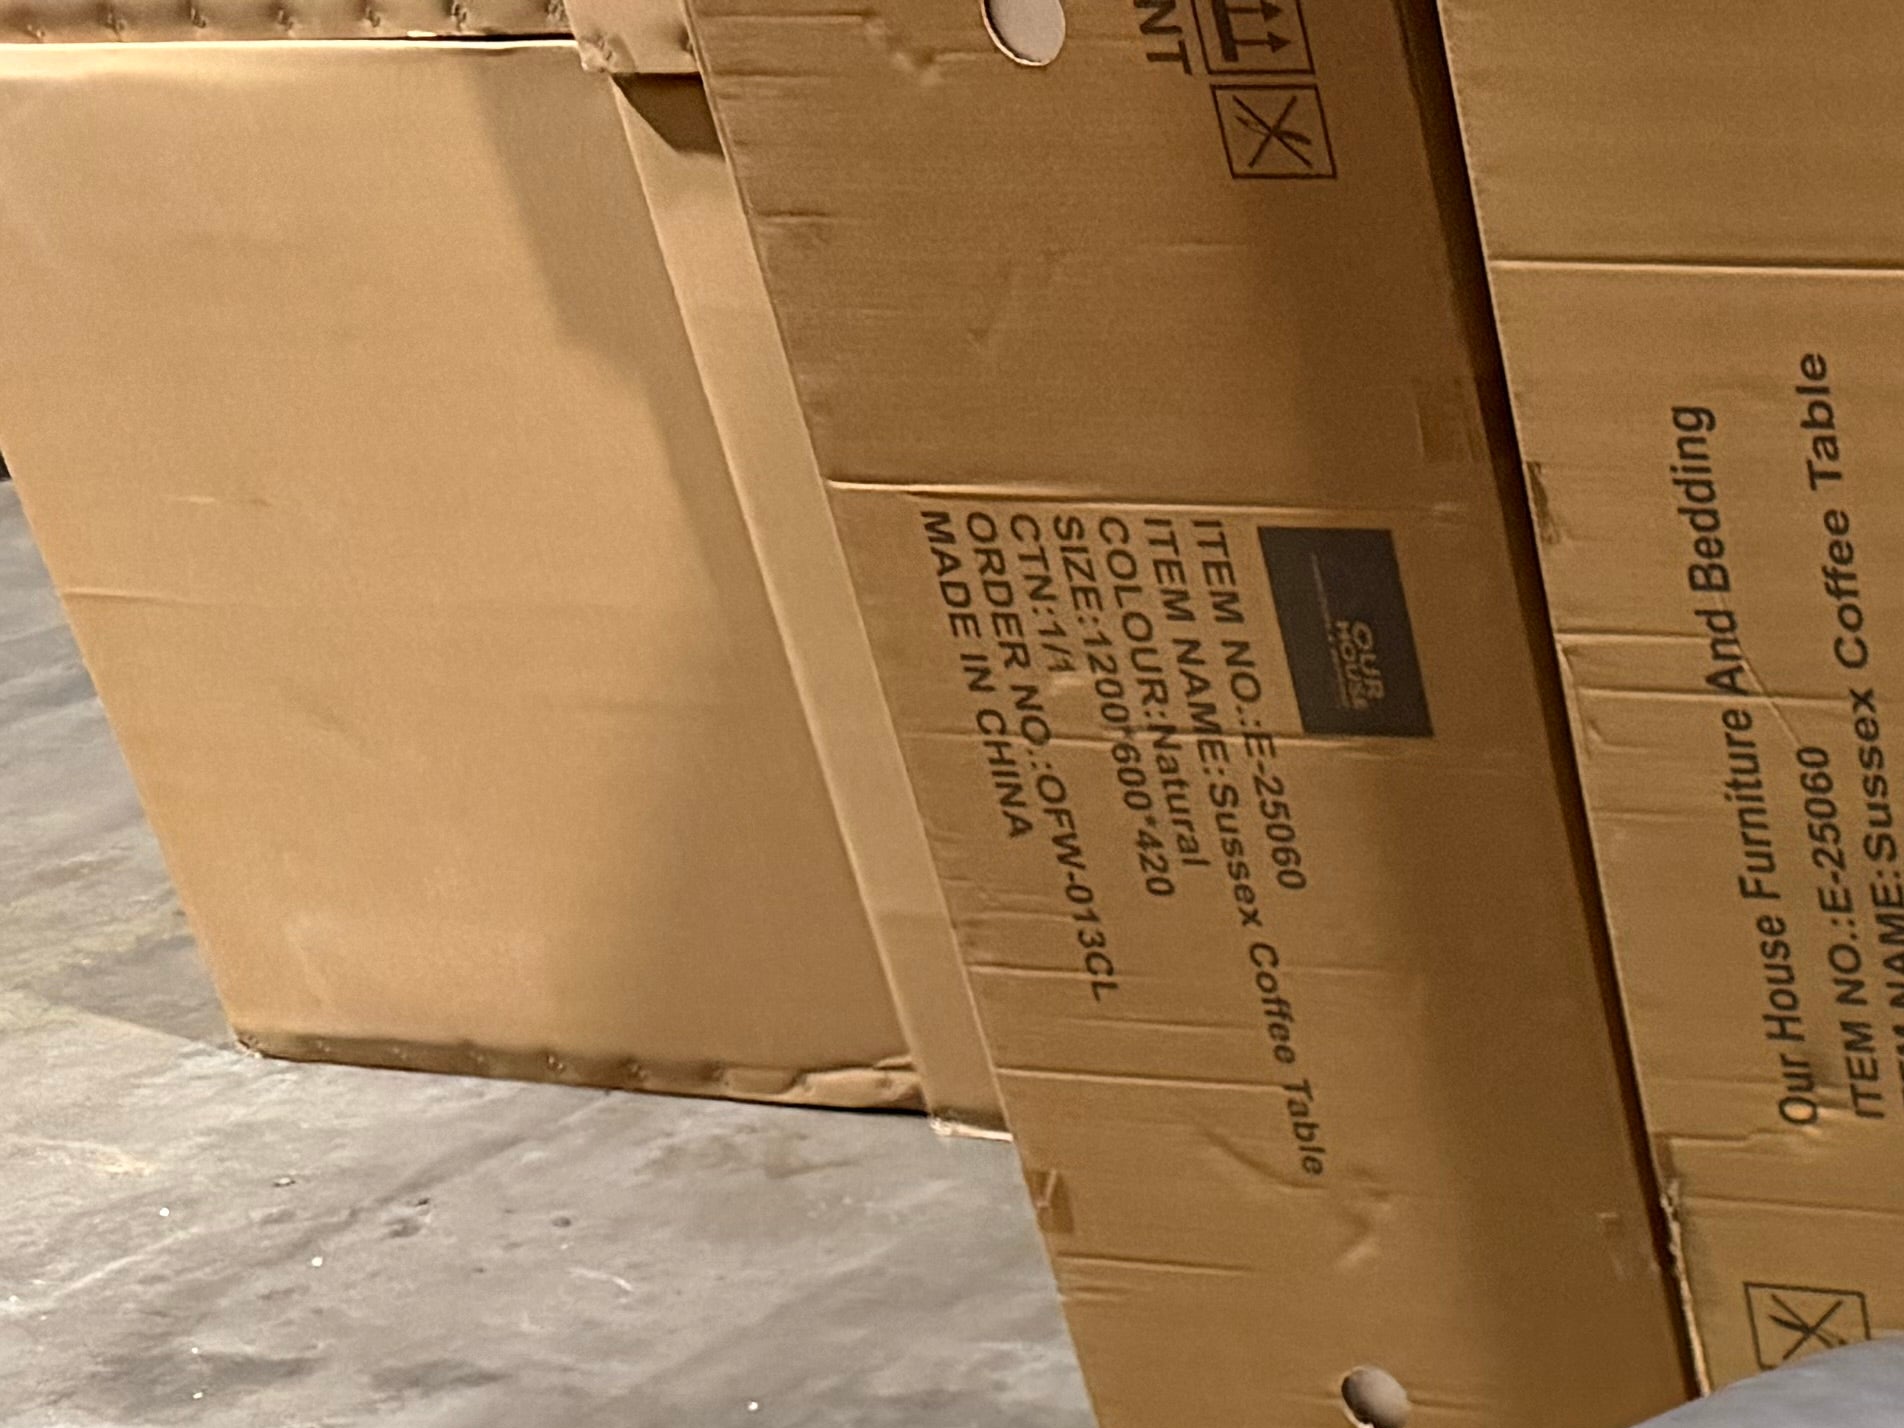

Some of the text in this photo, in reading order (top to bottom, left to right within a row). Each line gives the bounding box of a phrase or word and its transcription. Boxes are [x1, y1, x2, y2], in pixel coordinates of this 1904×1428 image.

[1010, 513, 1076, 673] CTN:1/1
[1795, 352, 1843, 491] Table
[1821, 508, 1869, 669] Coffee
[921, 510, 1034, 839] MADE IN CHINA
[966, 511, 1118, 1003] ORDER NO.:OFW-013CL
[1099, 516, 1211, 867] COLOUR:Natural
[1192, 520, 1307, 890] ITEM NO.:E-25060
[1351, 620, 1385, 700] OUR
[1670, 405, 1818, 1125] Our House Furniture And Bedding
[1144, 518, 1328, 1177] ITEM NAME:Sussex Coffee Table
[1796, 746, 1885, 1119] ITEM NO.:E-25060
